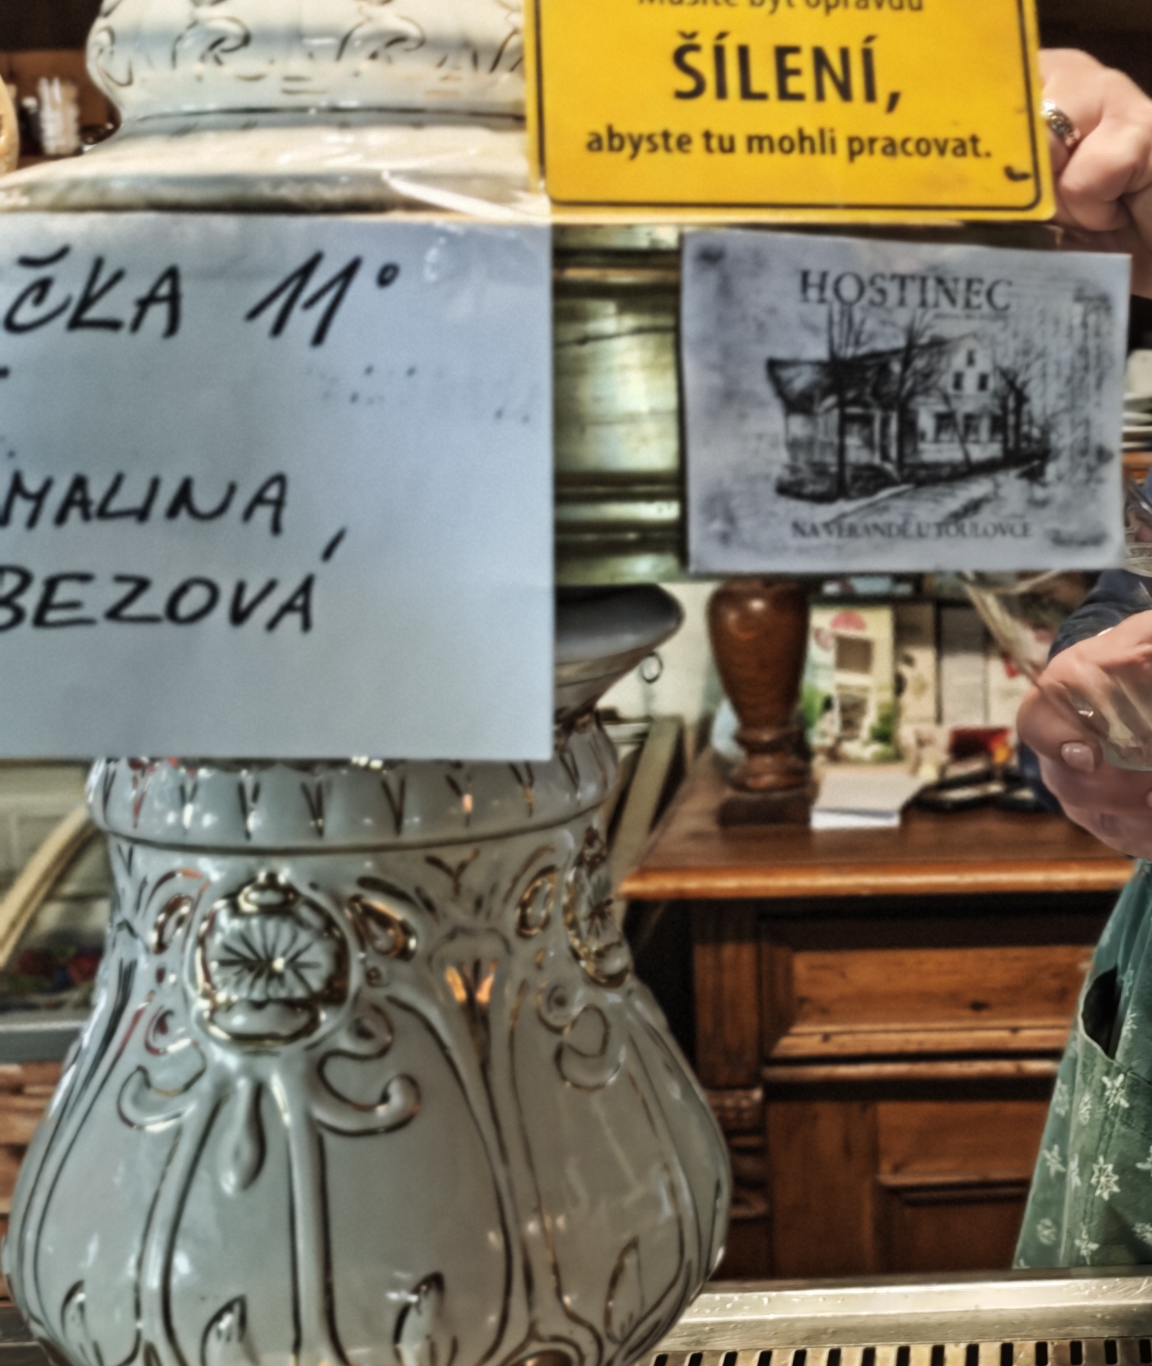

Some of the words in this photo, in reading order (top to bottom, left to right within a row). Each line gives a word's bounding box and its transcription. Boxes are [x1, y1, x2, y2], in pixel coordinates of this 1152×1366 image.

[672, 31, 902, 114] ŠÍLENÍ,
[586, 125, 693, 161] abyste
[702, 129, 736, 155] tu
[746, 127, 837, 155] mohli
[847, 134, 993, 163] pracovat.
[800, 269, 1013, 312] HOSTINEC
[0, 470, 287, 536] MALINA
[0, 527, 346, 633] BEZOVÁ
